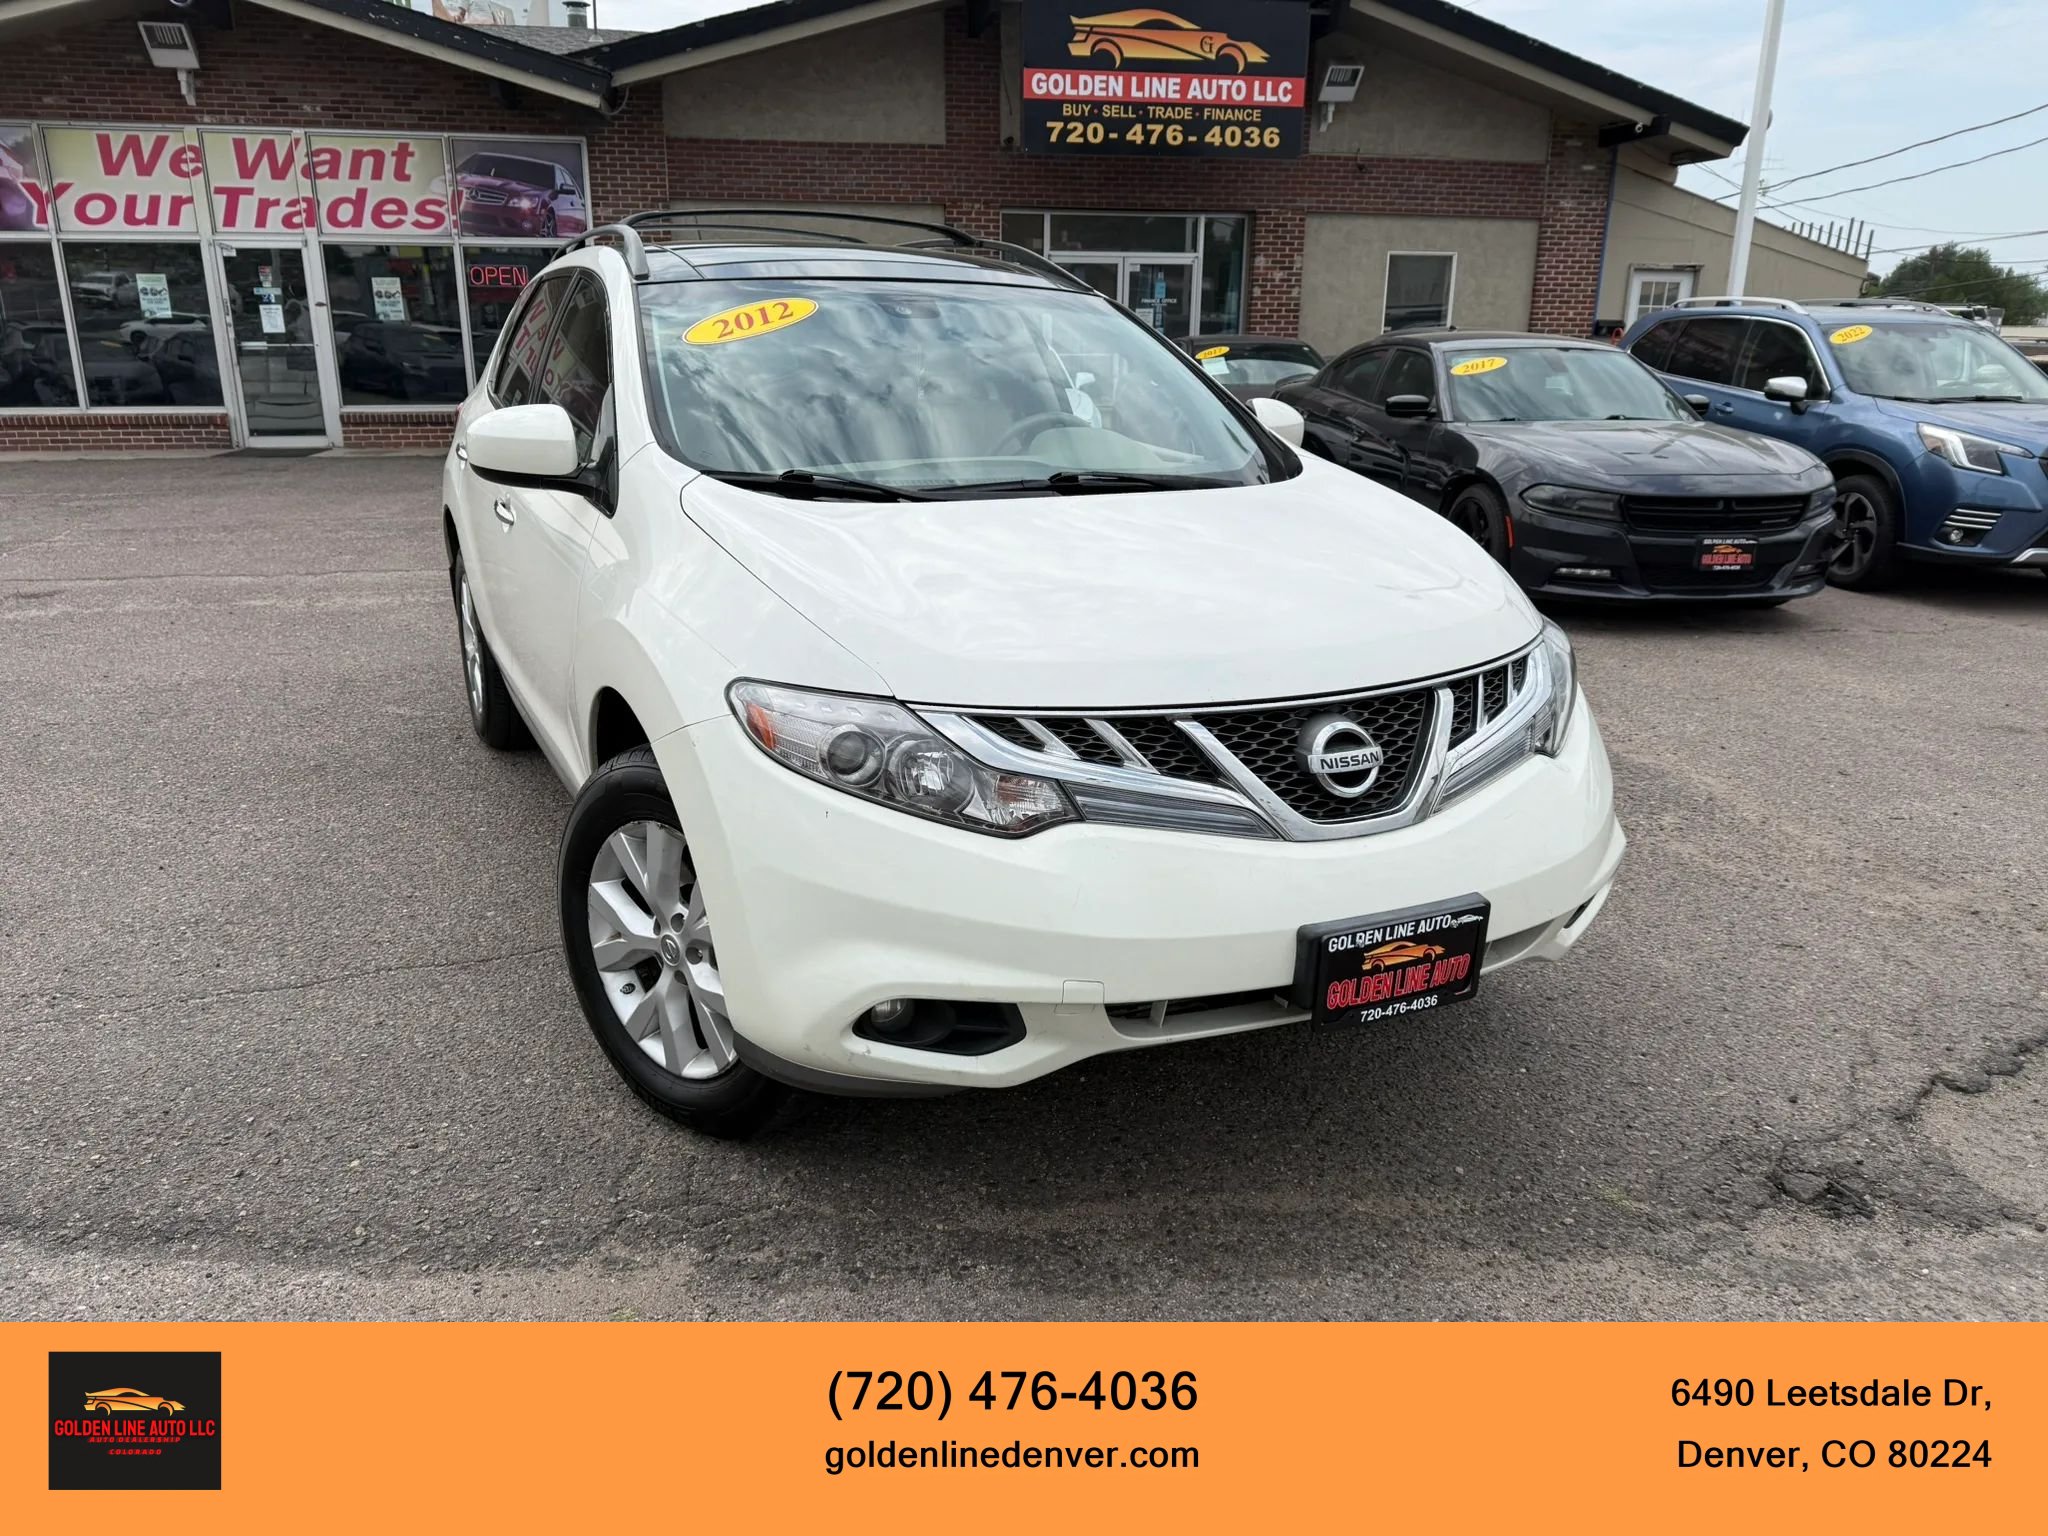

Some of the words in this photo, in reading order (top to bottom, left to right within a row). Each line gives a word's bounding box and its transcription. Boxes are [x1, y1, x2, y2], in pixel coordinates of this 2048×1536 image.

[1031, 73, 1124, 98] GOLDEN
[1130, 76, 1181, 99] LINE
[1187, 78, 1247, 101] AUTO
[1253, 80, 1293, 103] LLC
[1062, 104, 1091, 117] BUY
[1102, 105, 1136, 119] SELL
[1147, 106, 1192, 120] TRADE
[1203, 108, 1262, 122] FINANCE
[1046, 121, 1281, 148] 720-476-4036
[95, 133, 203, 179] We
[231, 137, 416, 183] Want
[20, 181, 196, 227] Your
[212, 185, 465, 231] Trades!
[469, 265, 528, 287] OPEN
[711, 301, 794, 339] 2012
[1837, 326, 1866, 342] 2022
[1463, 358, 1496, 373] 2017
[1320, 750, 1379, 770] NISSAN
[1328, 927, 1383, 953] GOLDEN
[1385, 921, 1416, 941] LINE
[1417, 914, 1452, 935] AUTO
[1326, 970, 1394, 1010] GOLDEN
[1393, 962, 1432, 997] LINE
[1429, 953, 1471, 988] AUTO
[1361, 995, 1438, 1022] 720-476-4036
